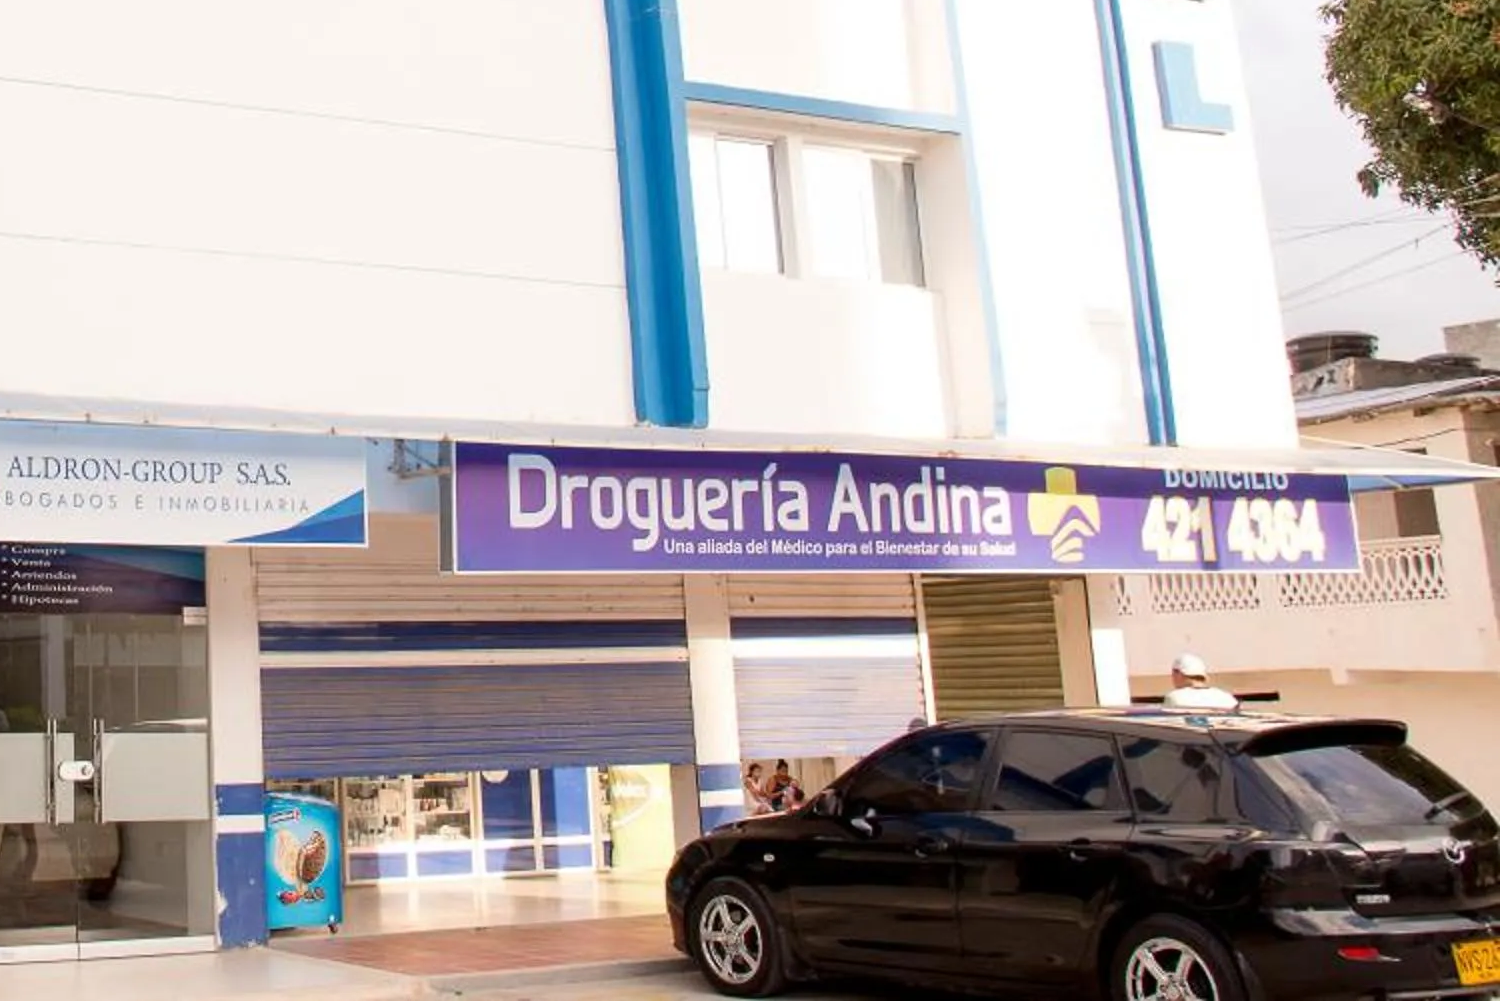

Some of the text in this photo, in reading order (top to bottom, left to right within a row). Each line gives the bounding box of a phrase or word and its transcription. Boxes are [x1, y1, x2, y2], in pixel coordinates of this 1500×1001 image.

[7, 455, 292, 486] ALDRON-GROUP S.A.S.
[1165, 470, 1289, 490] DOMICILIO
[134, 494, 144, 510] E
[159, 496, 311, 513] INMOBILIARIA
[507, 453, 1012, 551] Droguería Andina
[1142, 495, 1218, 563] 421
[11, 544, 66, 556] Compra
[664, 538, 1017, 558] Una aliada del Médico para el Bienestar de su Salud
[11, 570, 77, 580] Arriendos
[11, 582, 114, 594] Administración
[11, 595, 80, 607] Hipotecas
